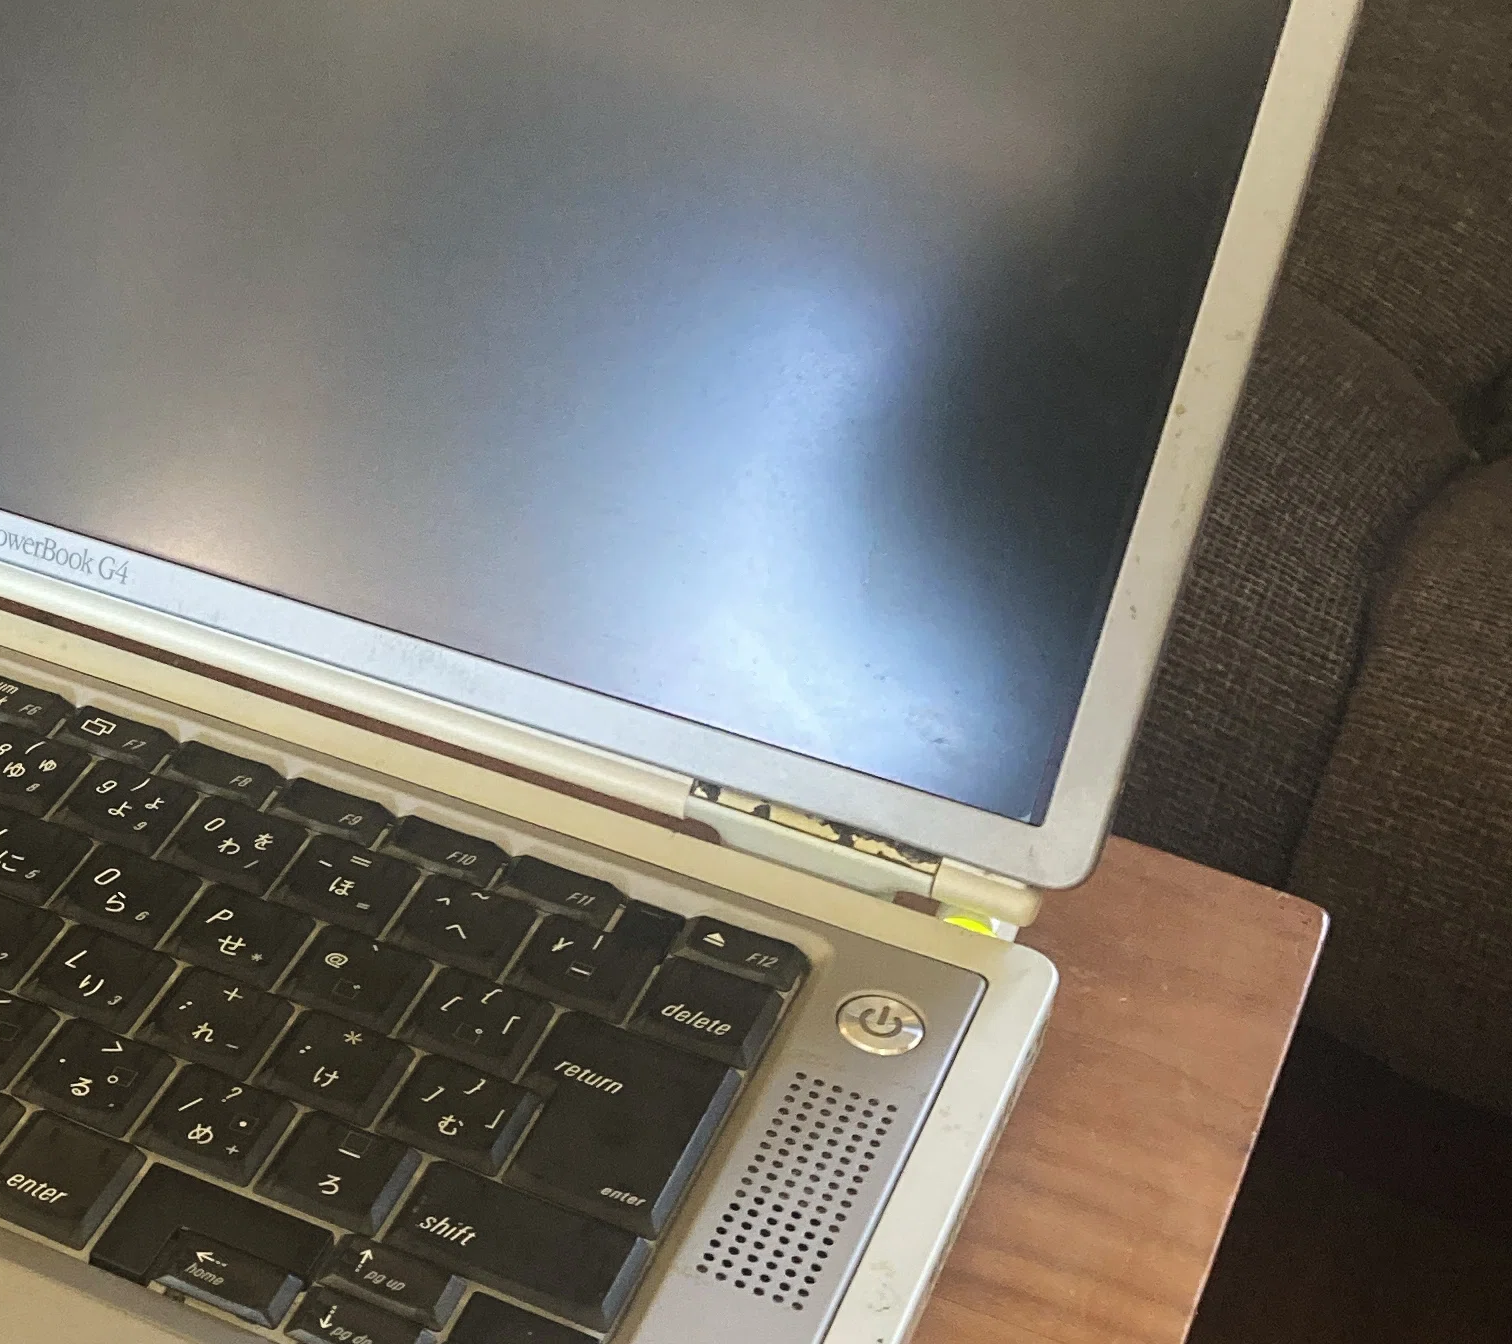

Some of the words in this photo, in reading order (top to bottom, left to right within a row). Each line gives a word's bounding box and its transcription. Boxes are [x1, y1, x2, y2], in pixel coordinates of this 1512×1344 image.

[98, 556, 130, 586] G4
[18, 703, 43, 716] F6
[121, 739, 147, 750] F7
[2, 761, 26, 778] ゆ
[95, 779, 118, 794] 9
[228, 775, 253, 788] F8
[107, 800, 133, 818] よ
[203, 817, 226, 832] 0
[338, 813, 363, 826] F9
[217, 837, 241, 855] わ
[254, 833, 274, 851] を
[445, 851, 478, 866] F10
[328, 876, 355, 896] ほ
[104, 891, 127, 913] ら
[565, 892, 596, 907] F11
[205, 908, 234, 924] P
[217, 935, 247, 956] せ
[64, 949, 88, 969] L
[324, 952, 349, 969] @
[745, 952, 779, 968] F12
[78, 974, 105, 997] り
[661, 1003, 732, 1036] delete
[191, 1022, 214, 1043] れ
[70, 1076, 93, 1097] る
[313, 1066, 340, 1088] け
[554, 1060, 623, 1095] return
[187, 1123, 214, 1145] め
[437, 1114, 464, 1136] む
[6, 1173, 68, 1204] enter
[318, 1174, 341, 1195] ろ
[600, 1187, 647, 1207] enter
[418, 1216, 476, 1246] shift
[183, 1261, 226, 1288] home
[363, 1270, 387, 1285] pg
[385, 1278, 406, 1291] up
[329, 1326, 353, 1341] pg
